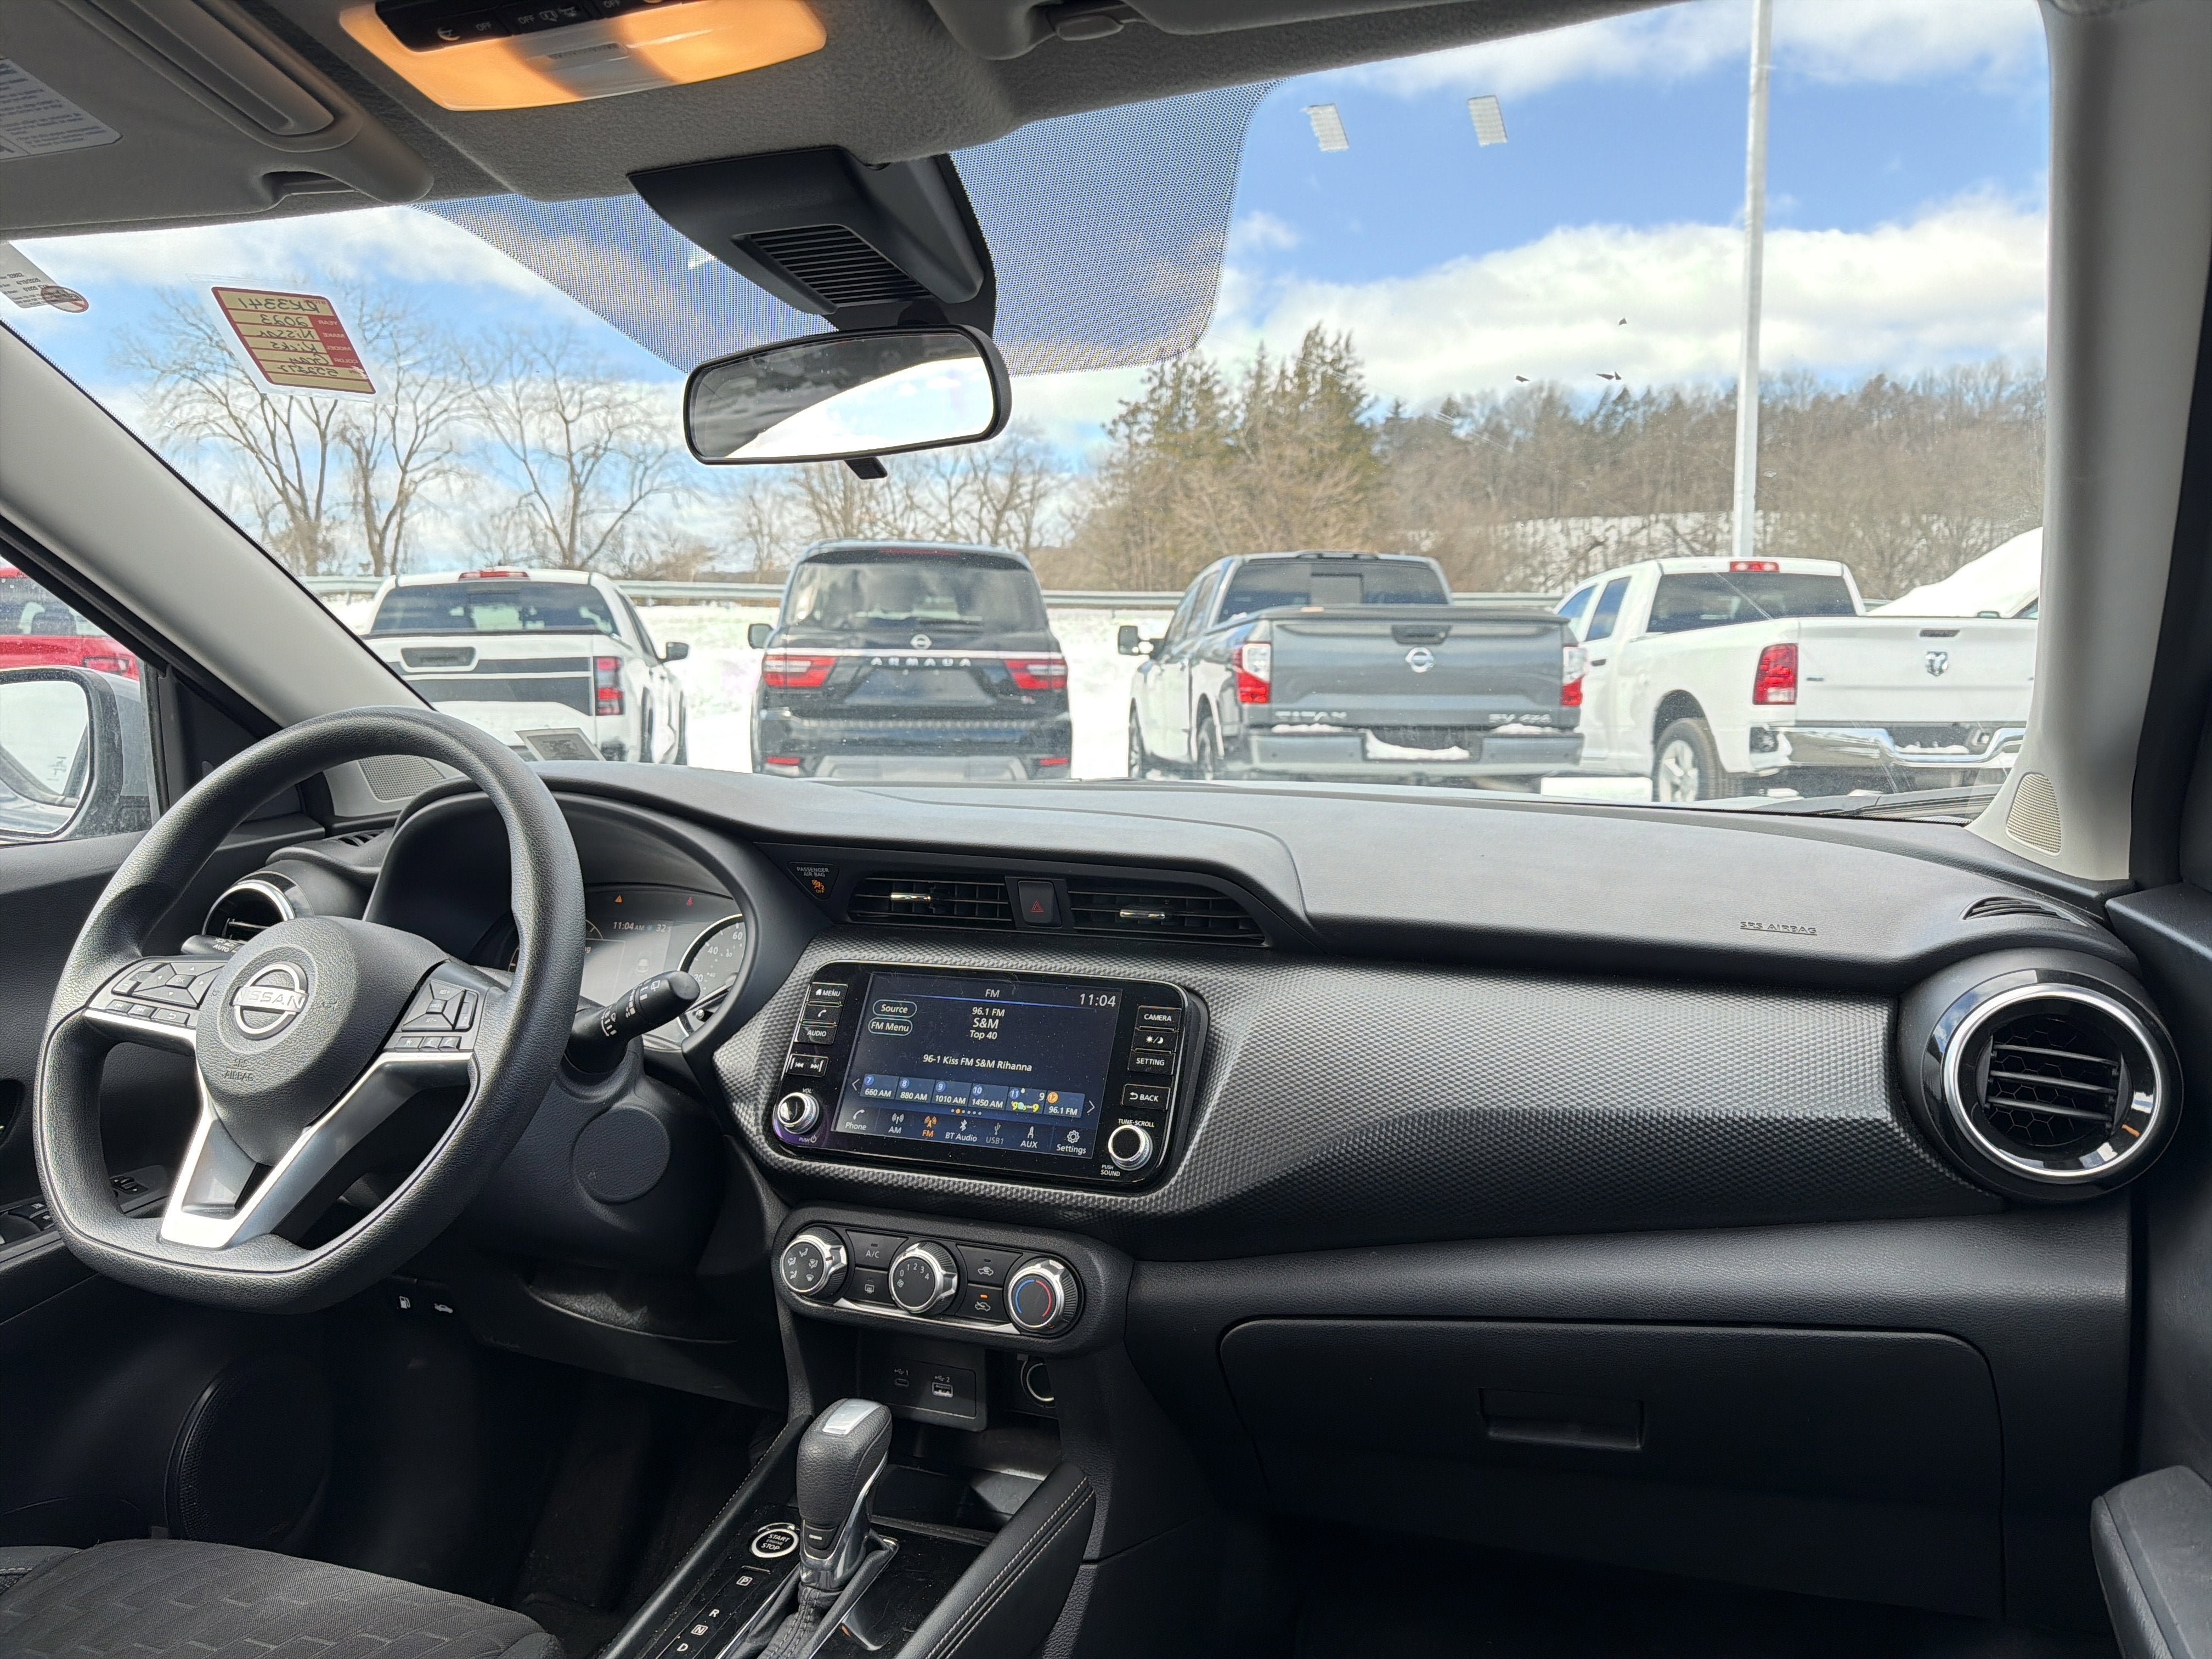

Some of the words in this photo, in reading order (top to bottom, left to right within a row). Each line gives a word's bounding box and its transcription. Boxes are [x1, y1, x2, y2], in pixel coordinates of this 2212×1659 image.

[518, 15, 534, 24] OFF
[476, 22, 492, 31] OFF
[1275, 711, 1347, 721] TITAN
[1768, 924, 1816, 933] AIRBAG
[732, 932, 743, 940] 60
[213, 944, 229, 952] AUTO
[985, 989, 1000, 998] FM
[234, 988, 306, 1009] NISSAN
[1080, 994, 1116, 1007] 11:04
[881, 1004, 908, 1013] Source
[972, 1007, 989, 1015] 96.1
[992, 1008, 1005, 1017] FM
[871, 1022, 884, 1030] FM
[885, 1023, 909, 1032] Menu
[973, 1018, 999, 1029] S&M
[969, 1030, 985, 1040] Top
[986, 1031, 997, 1040] 40
[923, 1054, 940, 1063] 96-1
[943, 1056, 959, 1065] Kiss
[960, 1057, 974, 1066] FM
[975, 1059, 995, 1068] S&M
[997, 1060, 1032, 1071] Rihanna
[1136, 1058, 1165, 1066] SETTING
[865, 1088, 878, 1096] 660
[878, 1089, 891, 1097] AM
[900, 1091, 913, 1099] 880
[1039, 1092, 1045, 1101] 9
[935, 1095, 951, 1103] 1010
[972, 1098, 989, 1107] 1450
[1049, 1106, 1064, 1114] 96.1
[845, 1121, 867, 1131] Phone
[955, 1133, 978, 1142] Audio
[986, 1136, 1004, 1145] USB1
[1020, 1140, 1039, 1149] AUX
[1056, 1144, 1087, 1155] Settings
[866, 1250, 879, 1259] A/C
[768, 1534, 791, 1543] START
[709, 1609, 720, 1618] R
[676, 1643, 689, 1652] D
